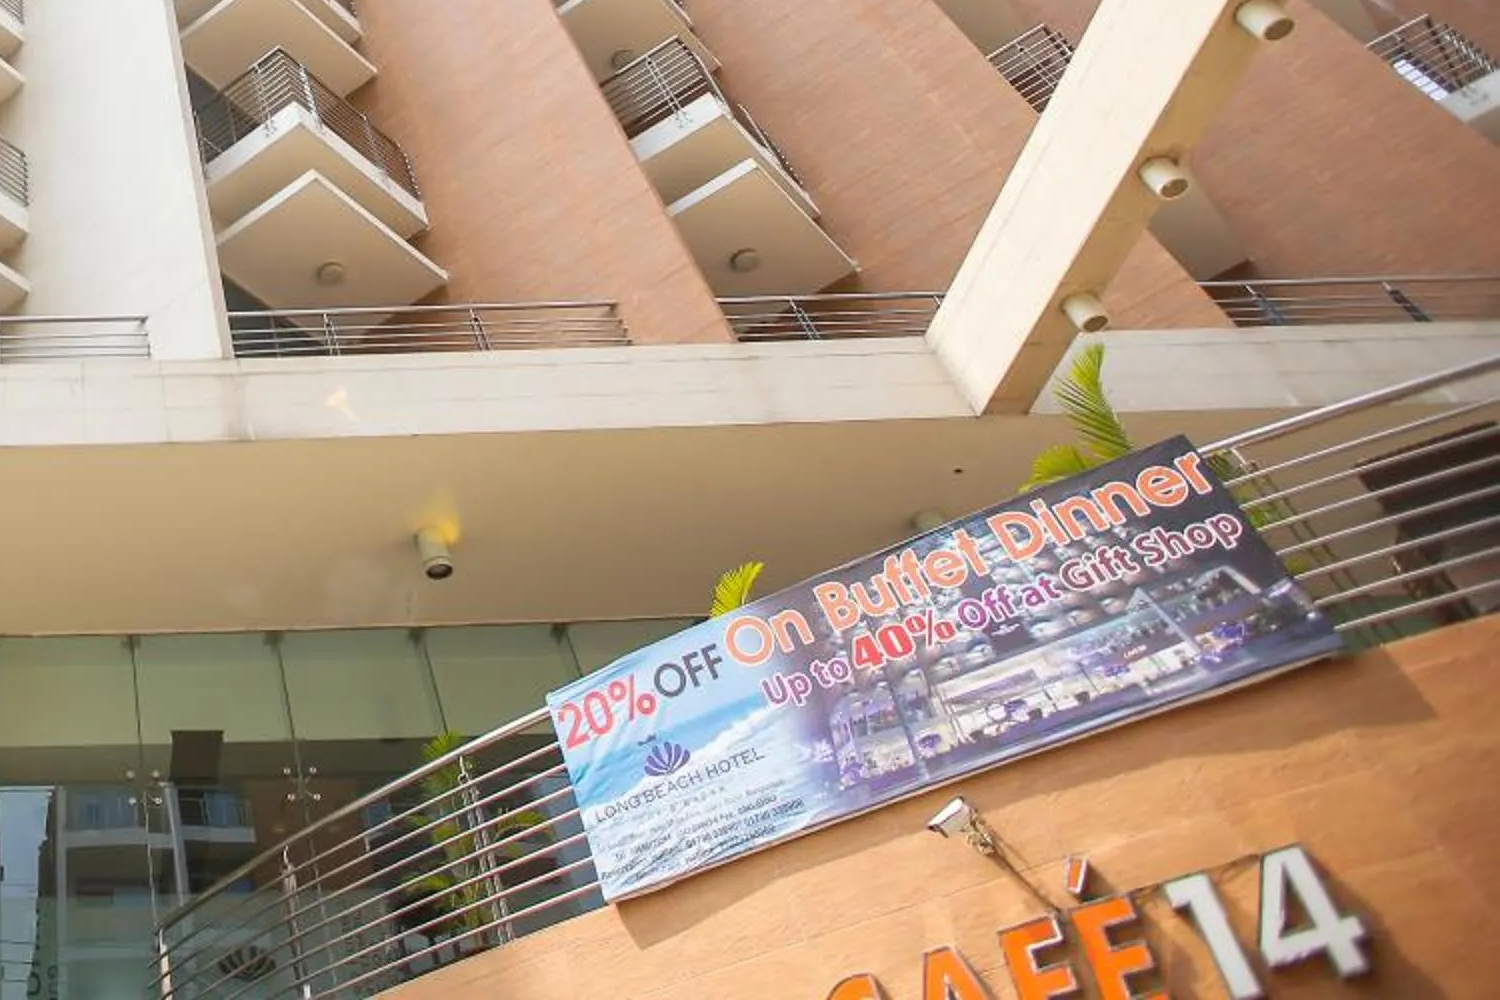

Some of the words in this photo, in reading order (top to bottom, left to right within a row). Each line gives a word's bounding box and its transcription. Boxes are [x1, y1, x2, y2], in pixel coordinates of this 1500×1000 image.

[557, 673, 657, 749] 20%
[653, 643, 723, 697] OFF
[725, 609, 815, 667] On
[813, 531, 989, 632] Buffet
[987, 452, 1214, 561] Dinner
[761, 671, 812, 706] Up
[812, 657, 850, 690] to
[851, 608, 956, 671] 40%
[956, 584, 1014, 631] Off
[1024, 575, 1062, 609] at
[1059, 546, 1140, 593] Gift
[1133, 512, 1244, 565] Shop
[595, 796, 642, 823] LONG
[642, 771, 704, 802] BEACH
[705, 747, 766, 779] HOTEL
[826, 856, 1170, 1000] AFÉ
[1165, 842, 1369, 1000] 14
